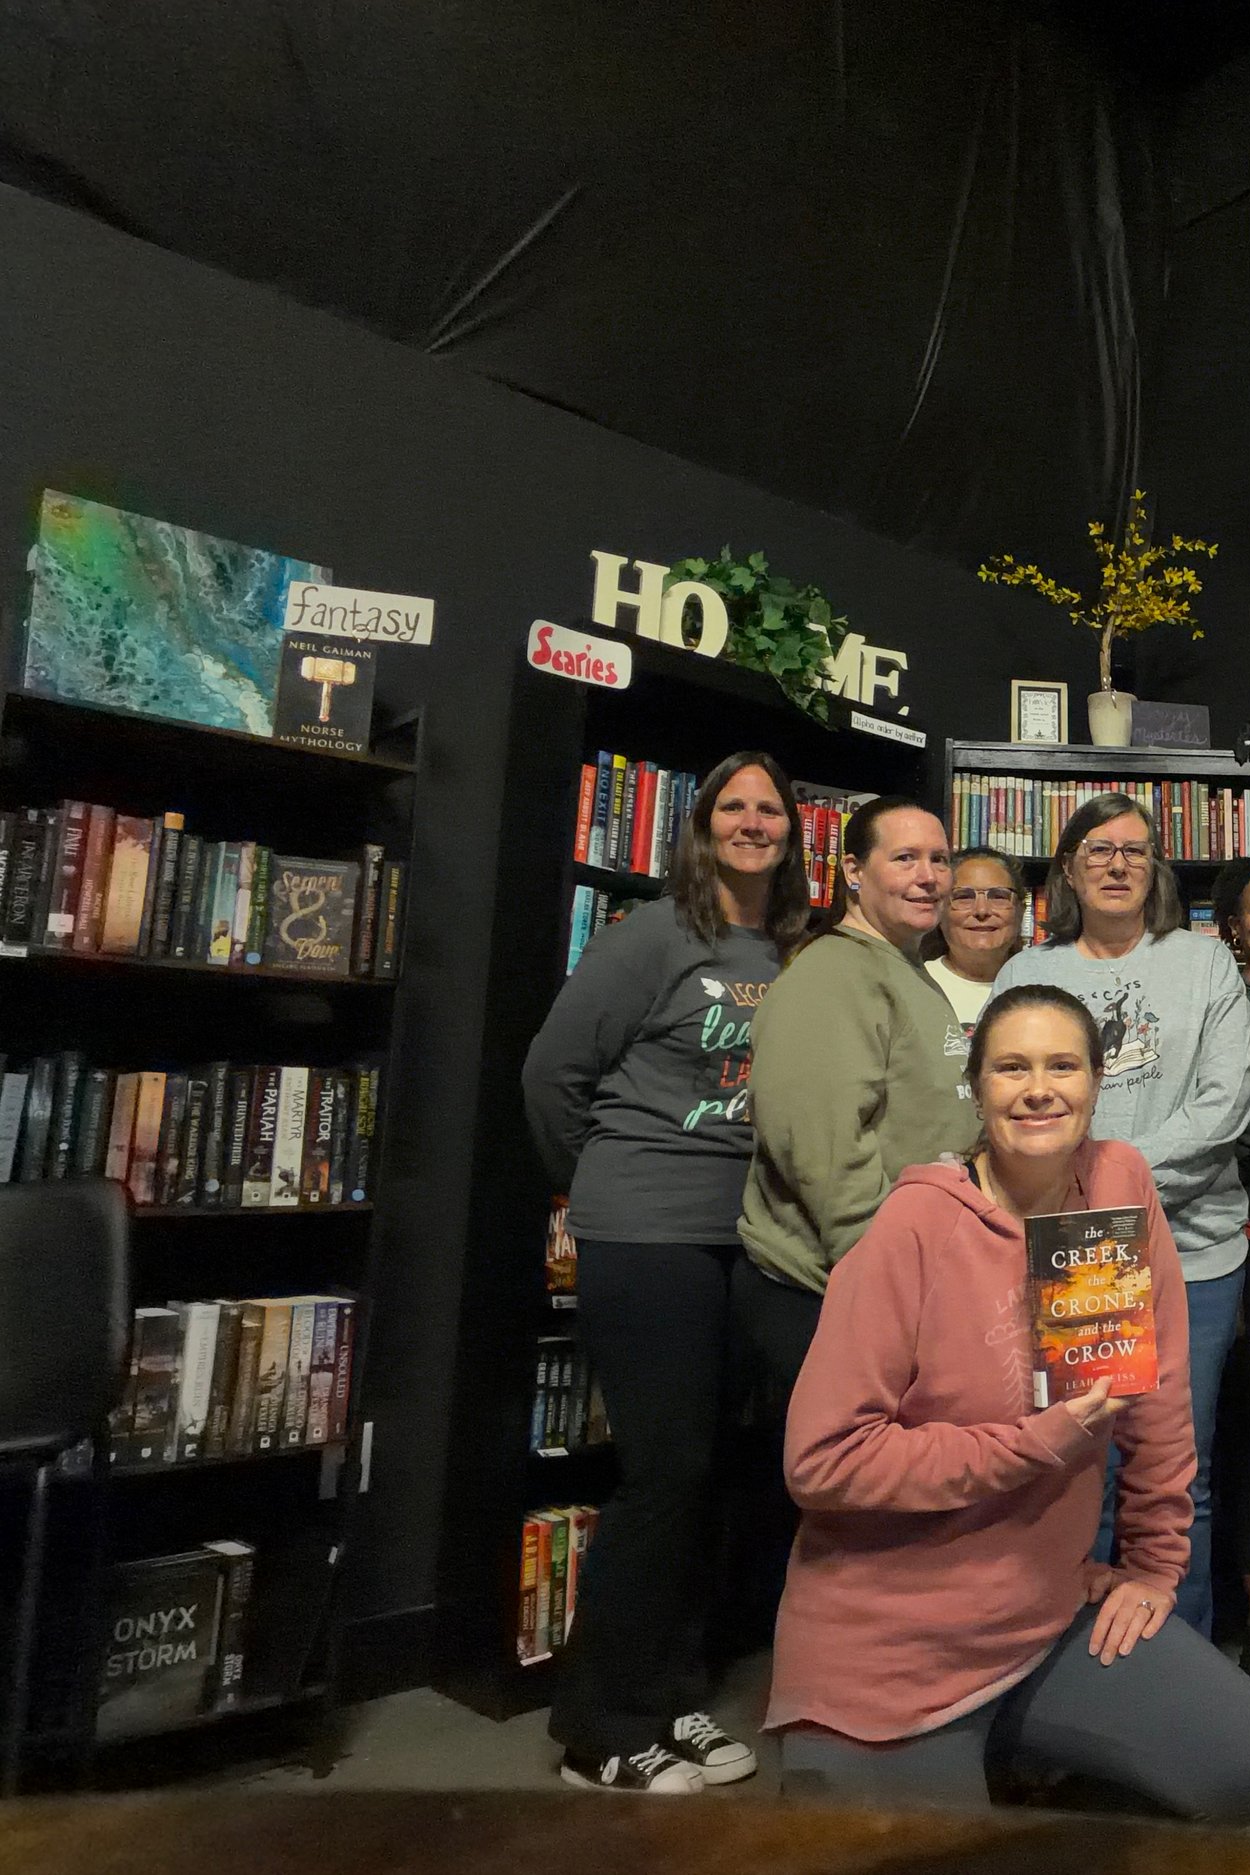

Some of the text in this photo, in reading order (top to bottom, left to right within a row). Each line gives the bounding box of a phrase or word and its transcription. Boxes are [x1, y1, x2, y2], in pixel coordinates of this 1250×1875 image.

[292, 586, 419, 641] fantasy
[288, 641, 371, 659] NEIL GAIMAN
[533, 626, 618, 684] Scaries
[280, 736, 362, 752] MYTHOLOGY
[300, 724, 344, 737] NORSE
[599, 768, 610, 788] NO
[597, 792, 607, 823] EXIT
[65, 827, 82, 856] FINALE
[282, 871, 343, 892] Serpent
[259, 1088, 277, 1141] PARIAH
[288, 1090, 305, 1140] MARTYR
[315, 1089, 334, 1142] TRAITOR
[185, 1159, 196, 1179] KING
[1085, 1226, 1103, 1238] the
[1051, 1243, 1139, 1269] CREEK,
[1088, 1275, 1105, 1286] the
[1051, 1290, 1144, 1318] CRONE,
[1078, 1320, 1121, 1337] and the
[1065, 1338, 1137, 1365] CROW
[336, 1345, 348, 1398] UNSOULED
[1066, 1377, 1094, 1390] LEAH
[114, 1603, 198, 1643] ONYX
[106, 1641, 197, 1677] STORM
[222, 1653, 235, 1686] STORM
[233, 1654, 244, 1681] ONYX
